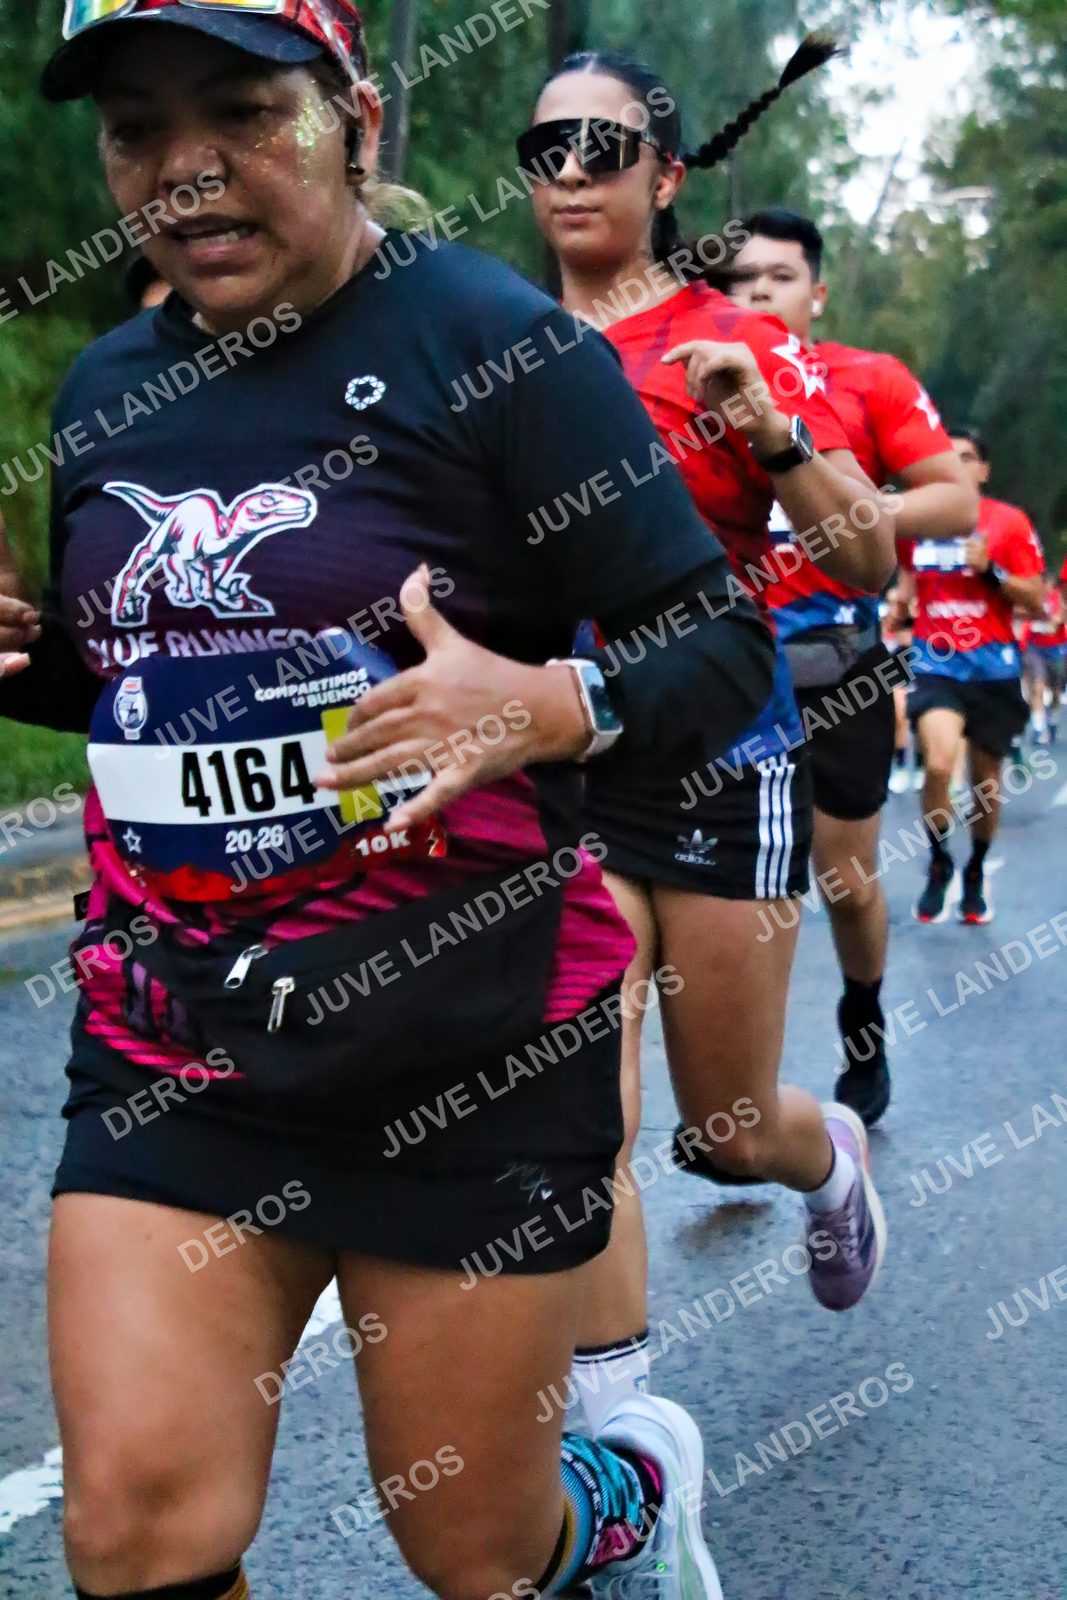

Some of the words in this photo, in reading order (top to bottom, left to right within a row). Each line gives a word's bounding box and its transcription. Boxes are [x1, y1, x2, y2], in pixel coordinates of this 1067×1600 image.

[254, 667, 368, 702] COMPARTIMOS
[181, 741, 317, 817] 4164
[355, 829, 411, 856] 10K
